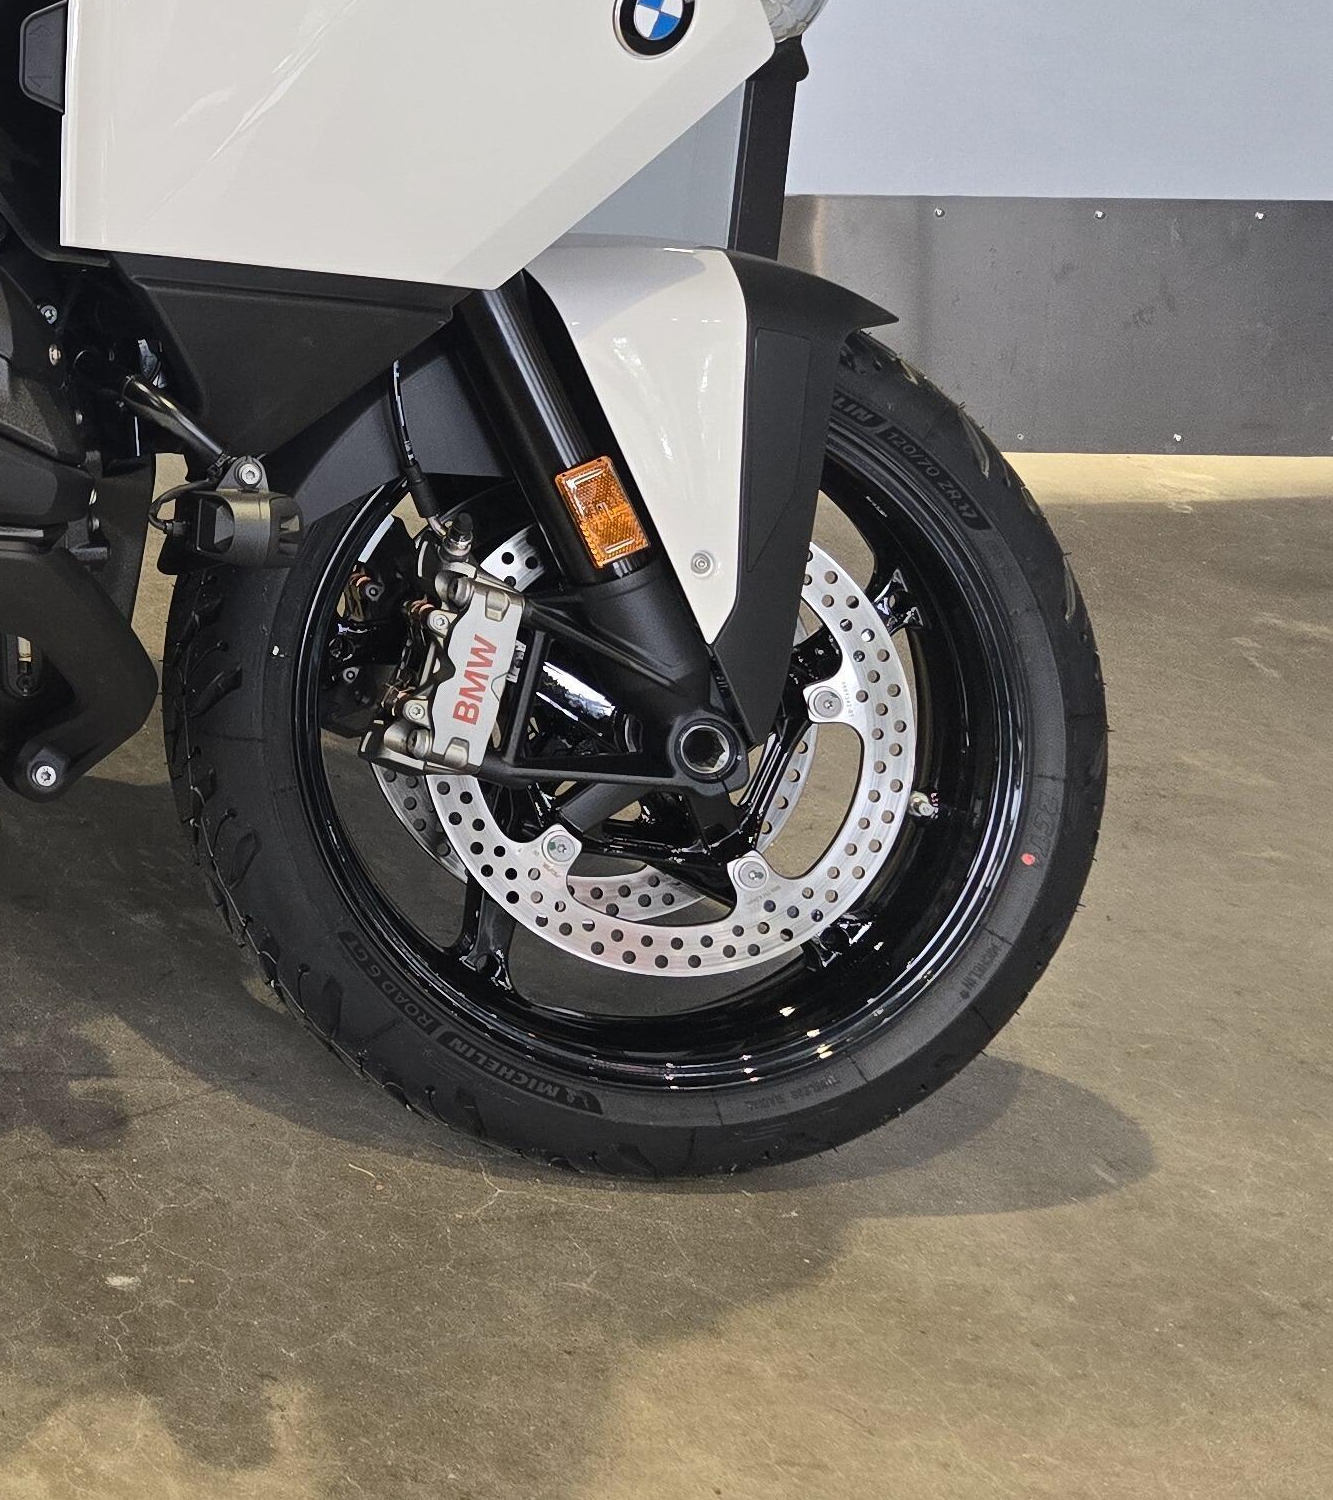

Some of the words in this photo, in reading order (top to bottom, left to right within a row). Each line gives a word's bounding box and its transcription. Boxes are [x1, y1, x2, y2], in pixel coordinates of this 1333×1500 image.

[886, 430, 940, 478] 120/70
[452, 633, 499, 726] BMW
[346, 937, 369, 962] GT
[368, 964, 382, 978] 6
[381, 980, 434, 1029] ROAD
[448, 1037, 561, 1099] MICHELIN
